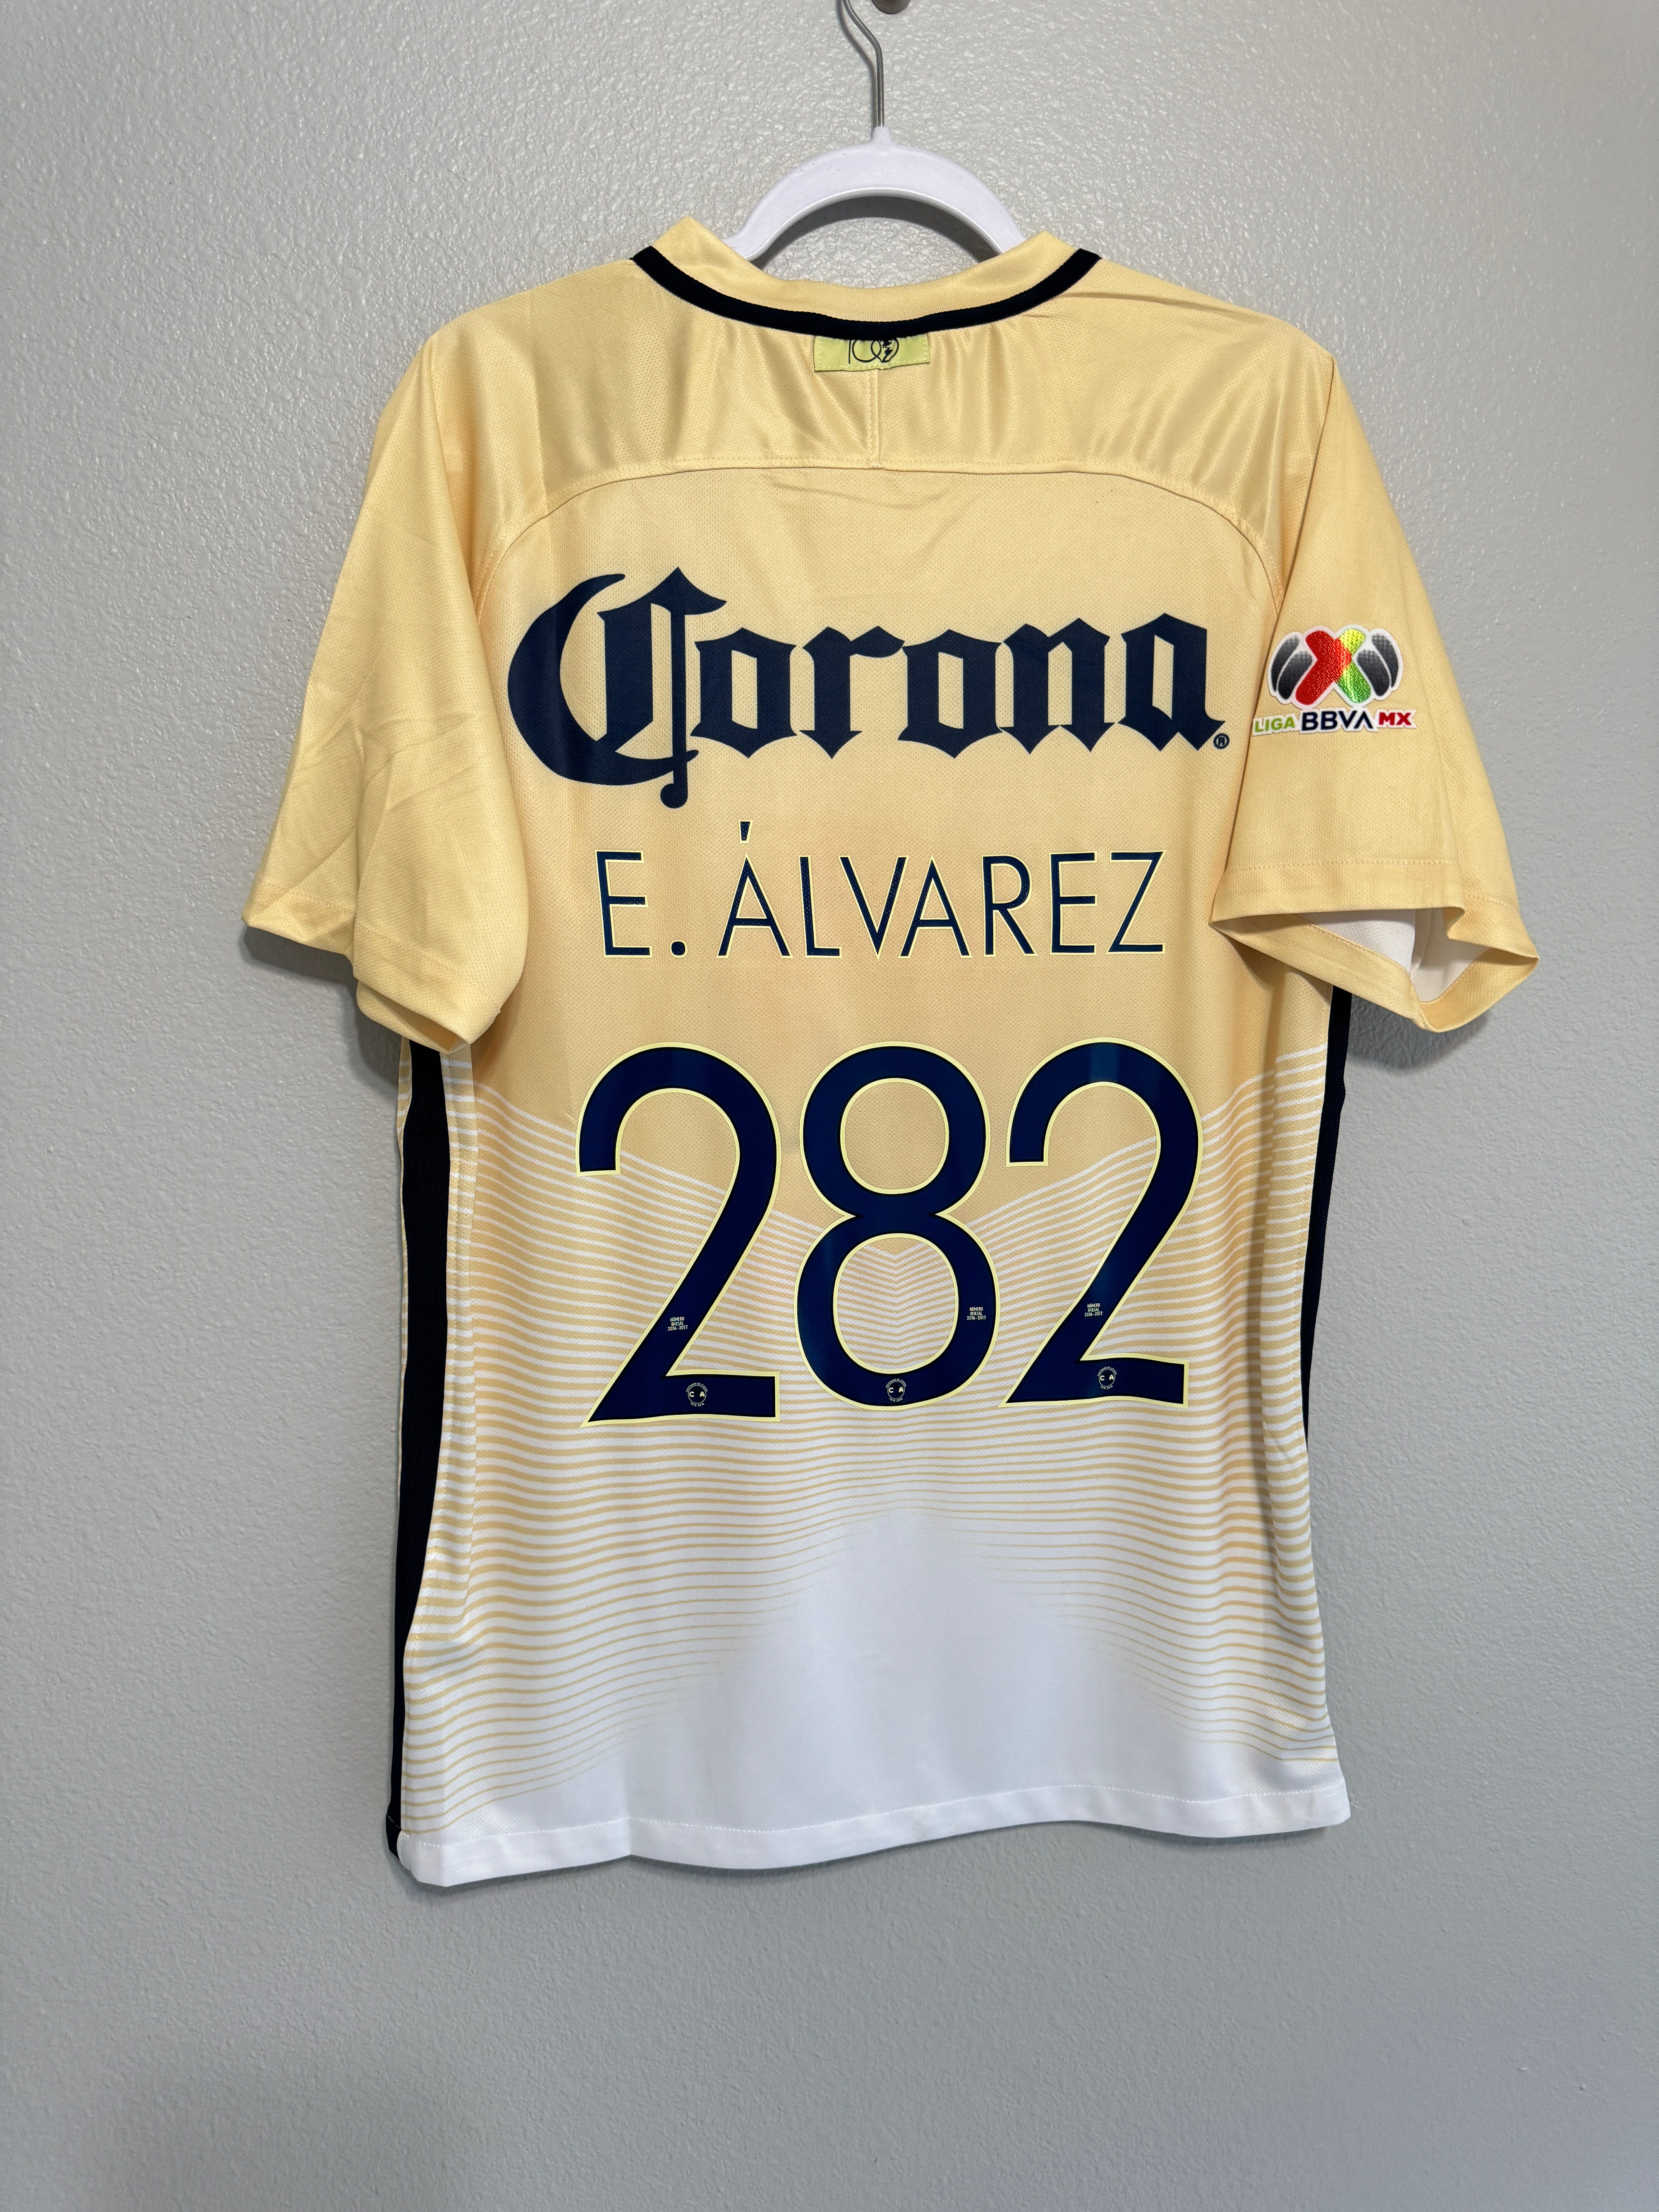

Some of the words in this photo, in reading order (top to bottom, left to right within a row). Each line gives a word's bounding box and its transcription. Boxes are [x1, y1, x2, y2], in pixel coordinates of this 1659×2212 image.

[1255, 718, 1295, 733] LIGA
[1301, 710, 1374, 731] BBVA
[1378, 712, 1412, 726] MX
[595, 849, 688, 958] E.
[716, 819, 1167, 959] ÁLVAREZ
[575, 1037, 1203, 1428] 282
